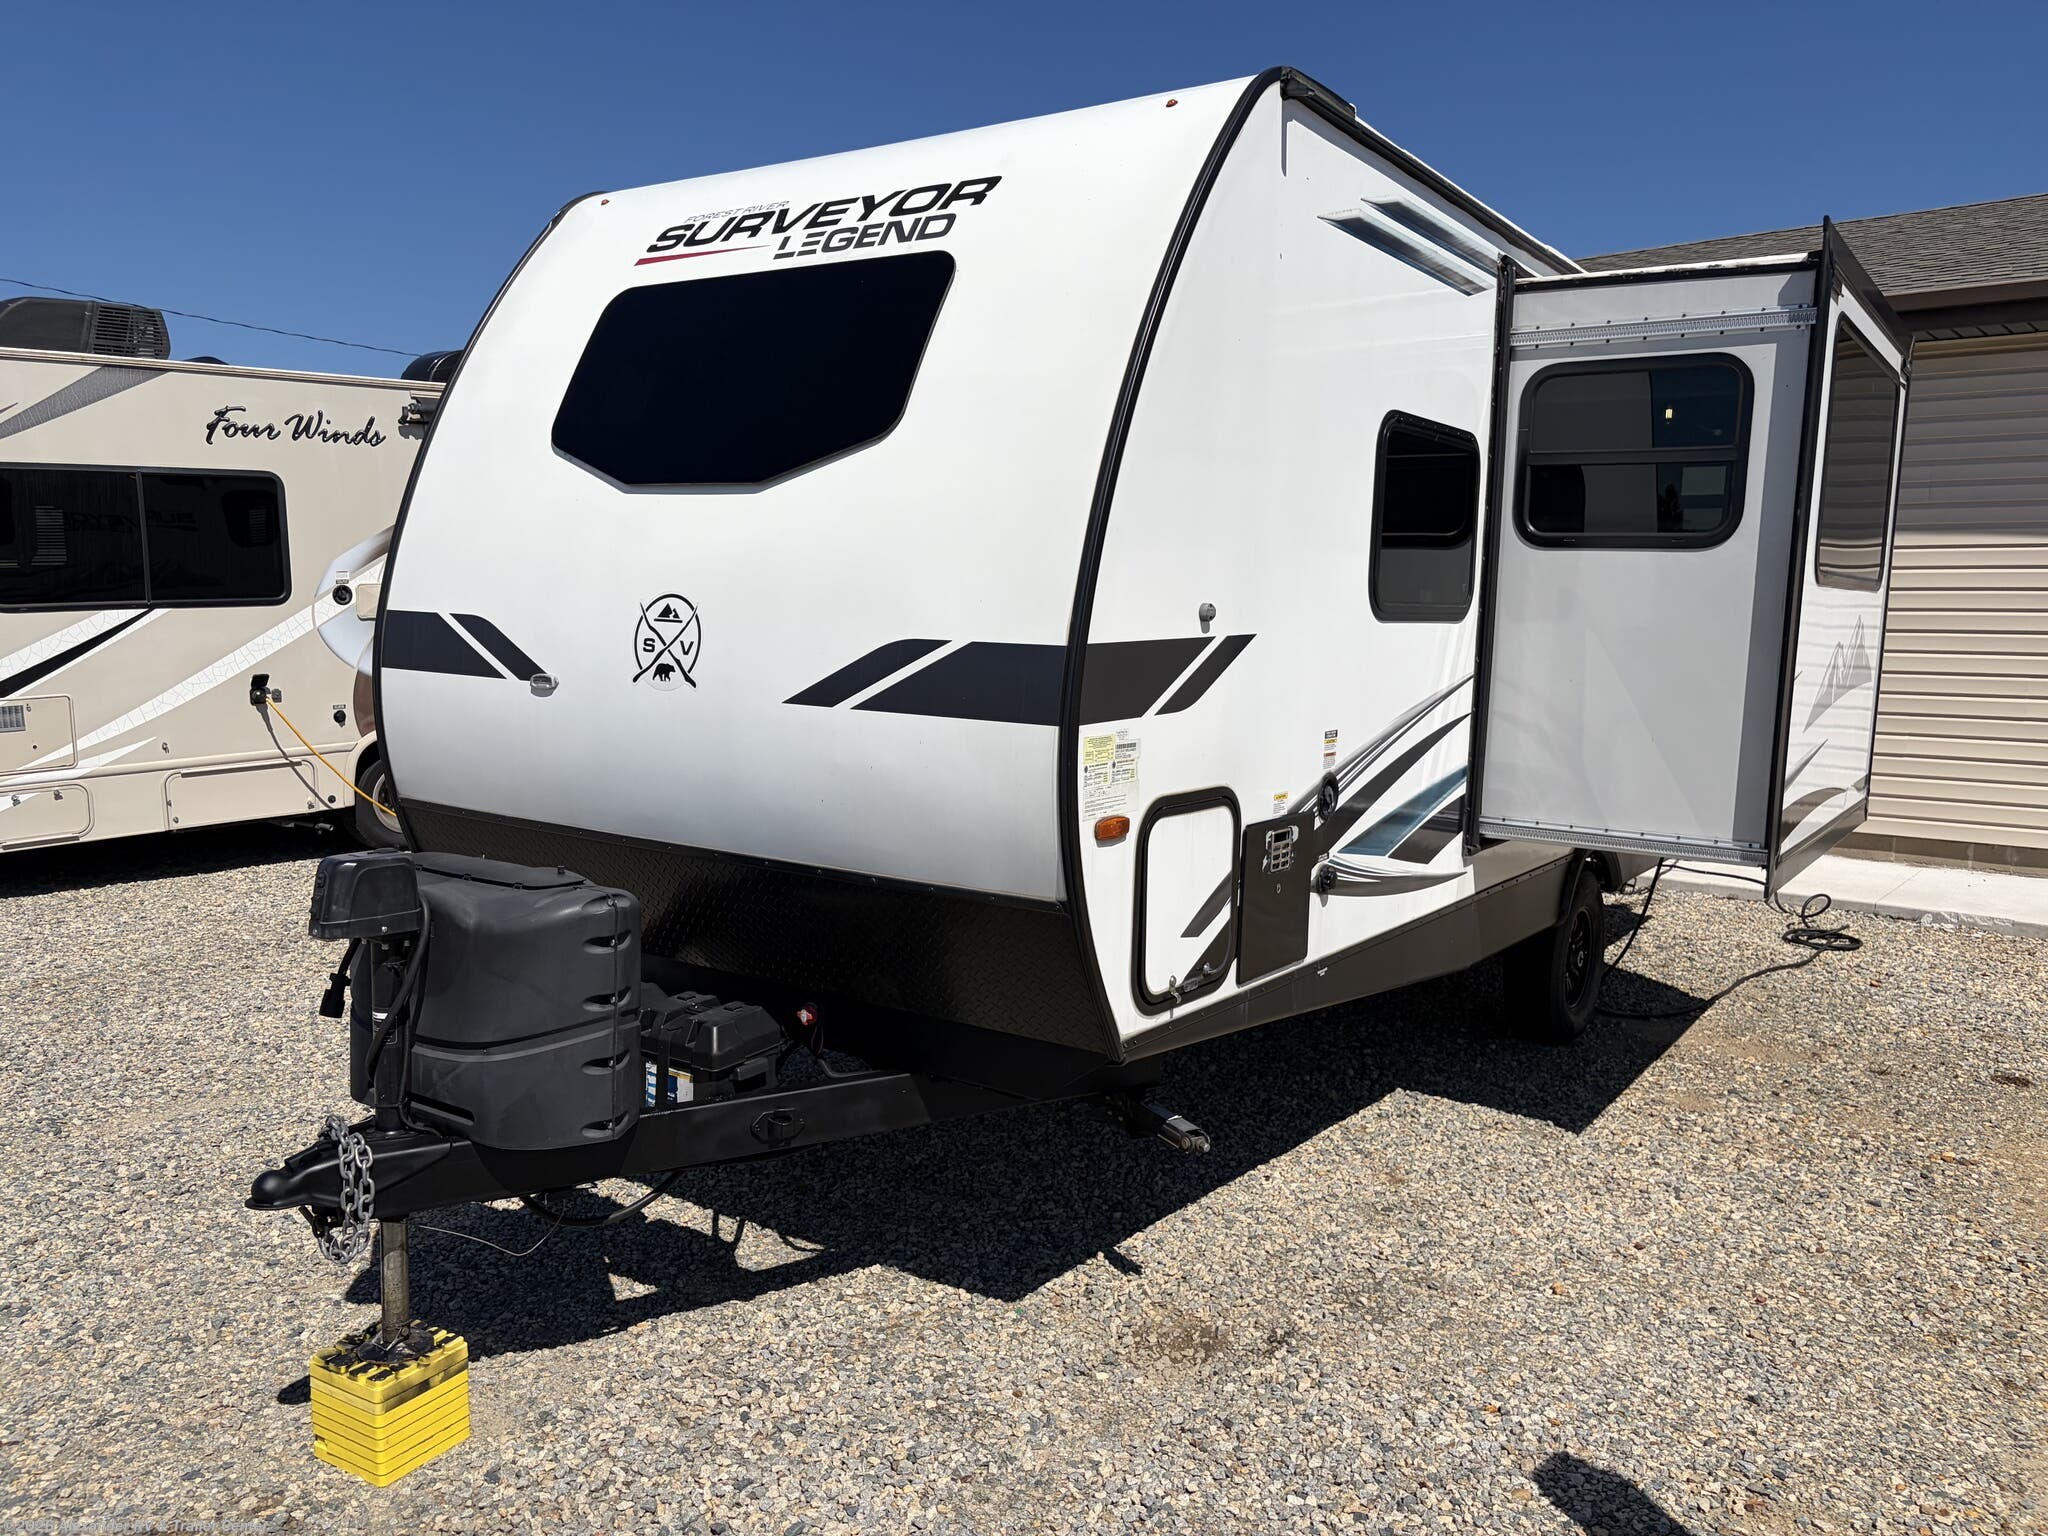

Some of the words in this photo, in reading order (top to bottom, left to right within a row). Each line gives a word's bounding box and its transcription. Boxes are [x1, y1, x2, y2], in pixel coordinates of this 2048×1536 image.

[646, 175, 1002, 253] SURVEYOR
[684, 207, 744, 223] FOREST
[742, 200, 790, 214] RIVER
[773, 213, 956, 260] LEGEND
[205, 405, 281, 445] Four
[284, 410, 386, 447] Winds
[643, 638, 656, 653] S
[680, 640, 694, 655] V
